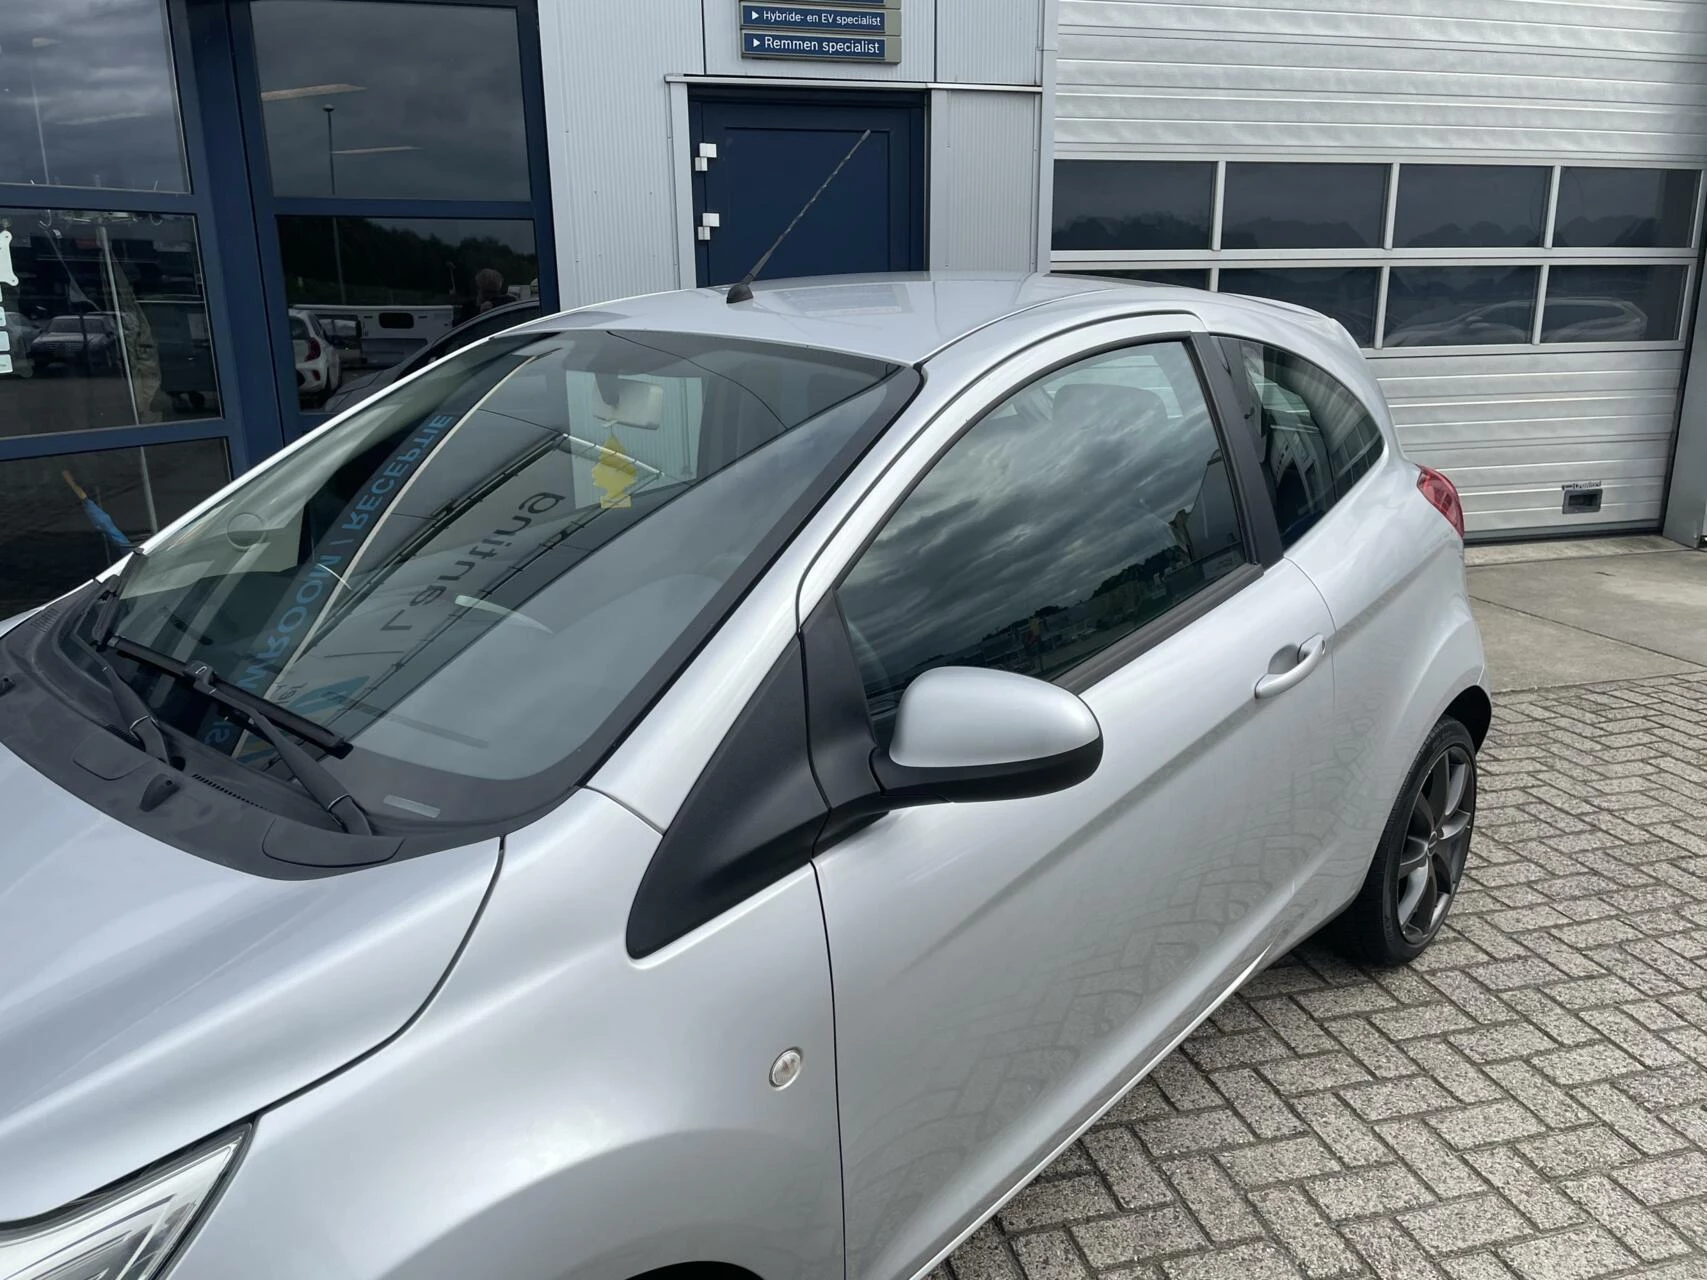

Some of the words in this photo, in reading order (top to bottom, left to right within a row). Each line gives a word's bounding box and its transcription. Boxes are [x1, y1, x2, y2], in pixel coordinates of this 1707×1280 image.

[763, 10, 804, 22] Hybride-
[806, 14, 819, 23] en
[821, 13, 834, 23] EV
[836, 15, 881, 26] specialist
[764, 36, 819, 51] Remmen
[822, 39, 880, 54] specialist
